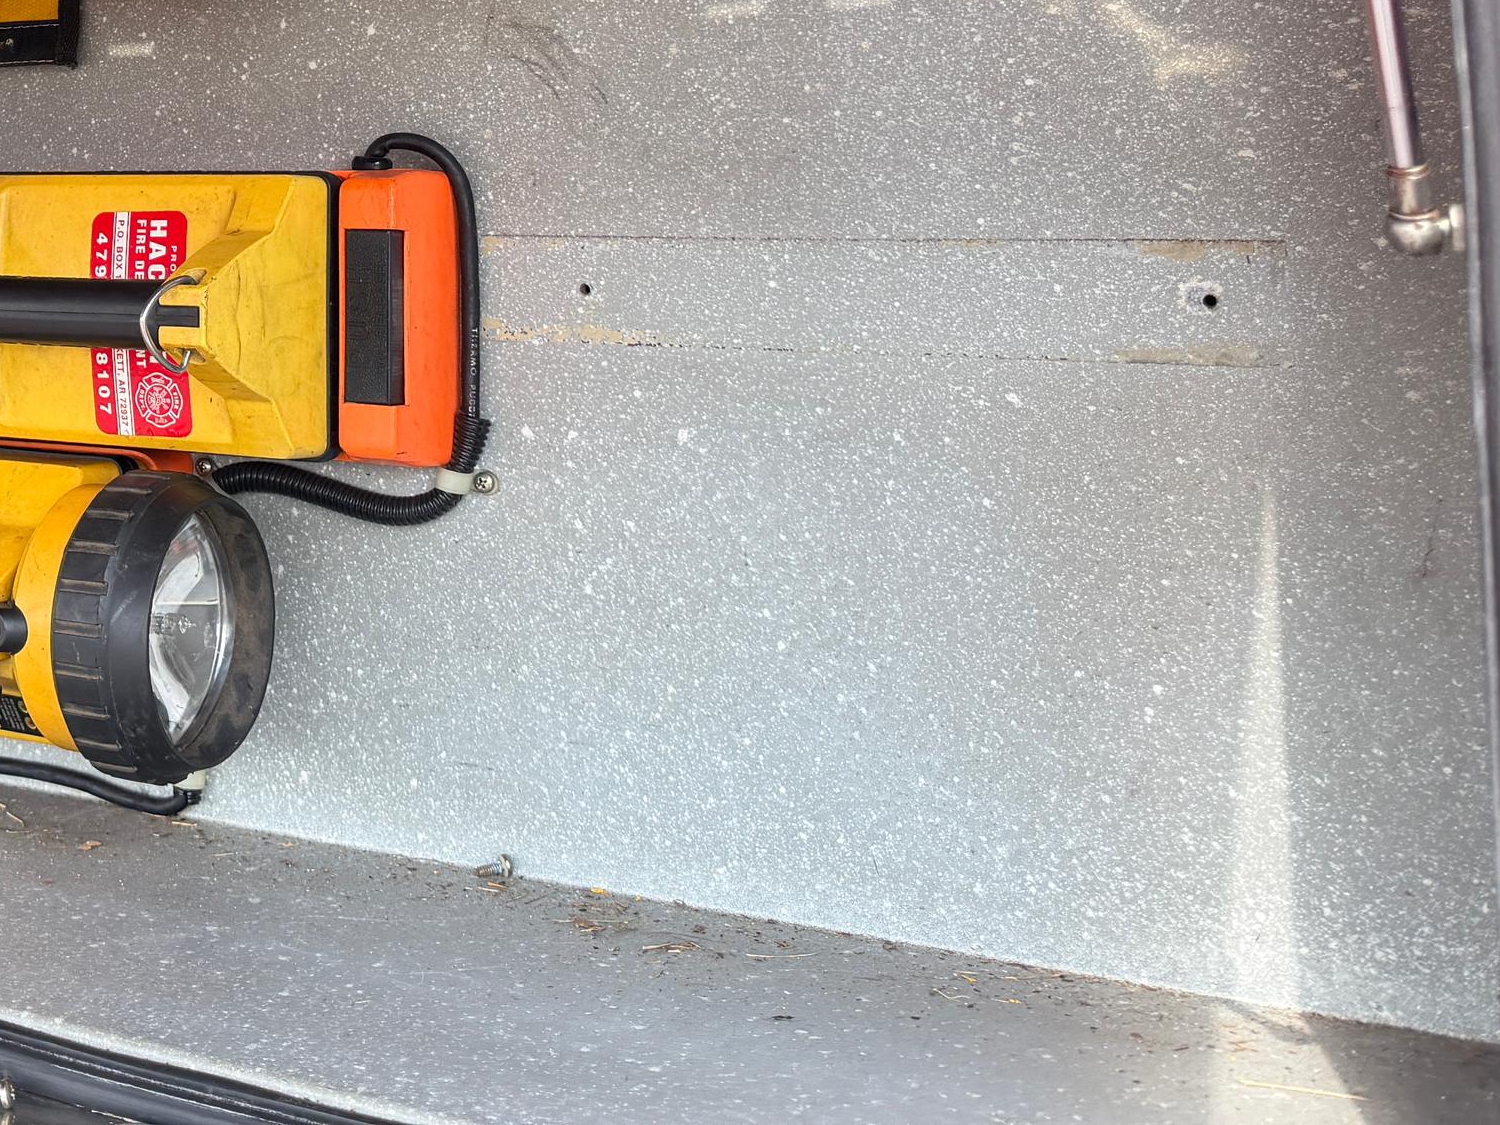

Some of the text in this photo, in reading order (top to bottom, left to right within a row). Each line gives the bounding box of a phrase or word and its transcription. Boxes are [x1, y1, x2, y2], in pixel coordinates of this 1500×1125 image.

[116, 219, 125, 242] P.O.
[135, 219, 147, 254] FIRE
[115, 246, 124, 270] BOX
[118, 379, 126, 394] AR
[119, 398, 129, 426] 72937
